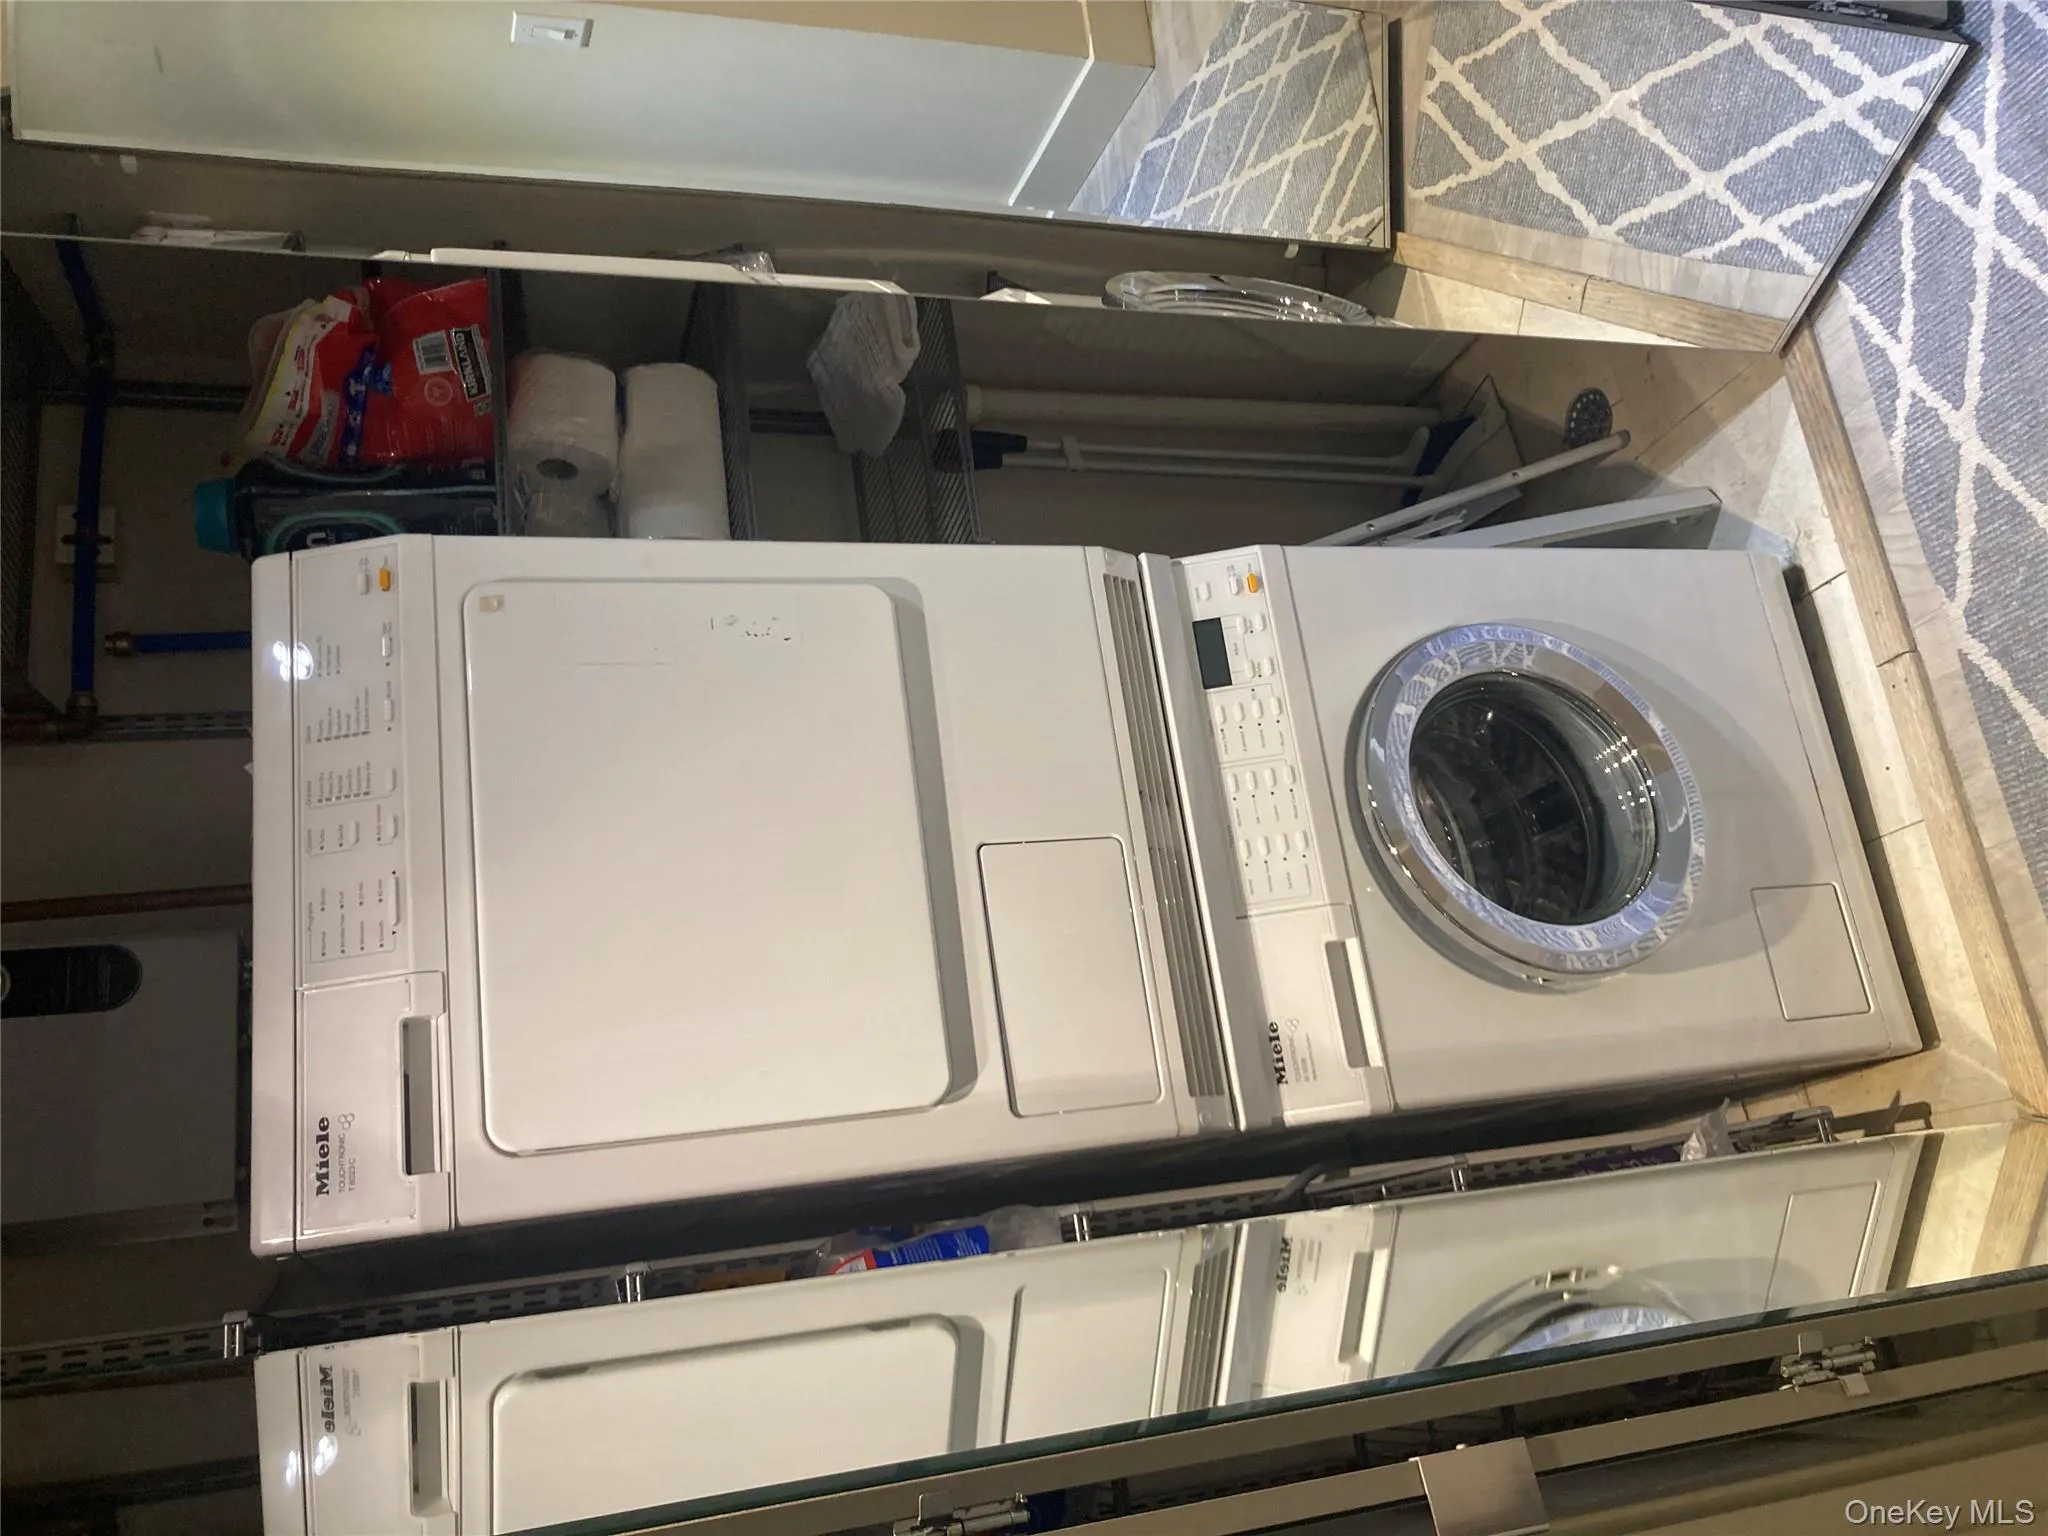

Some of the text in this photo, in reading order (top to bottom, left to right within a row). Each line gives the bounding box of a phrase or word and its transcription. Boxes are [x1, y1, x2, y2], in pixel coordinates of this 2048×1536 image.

[453, 332, 479, 396] KIRKLAND
[1268, 1022, 1289, 1087] Miele
[315, 1116, 330, 1197] Miele
